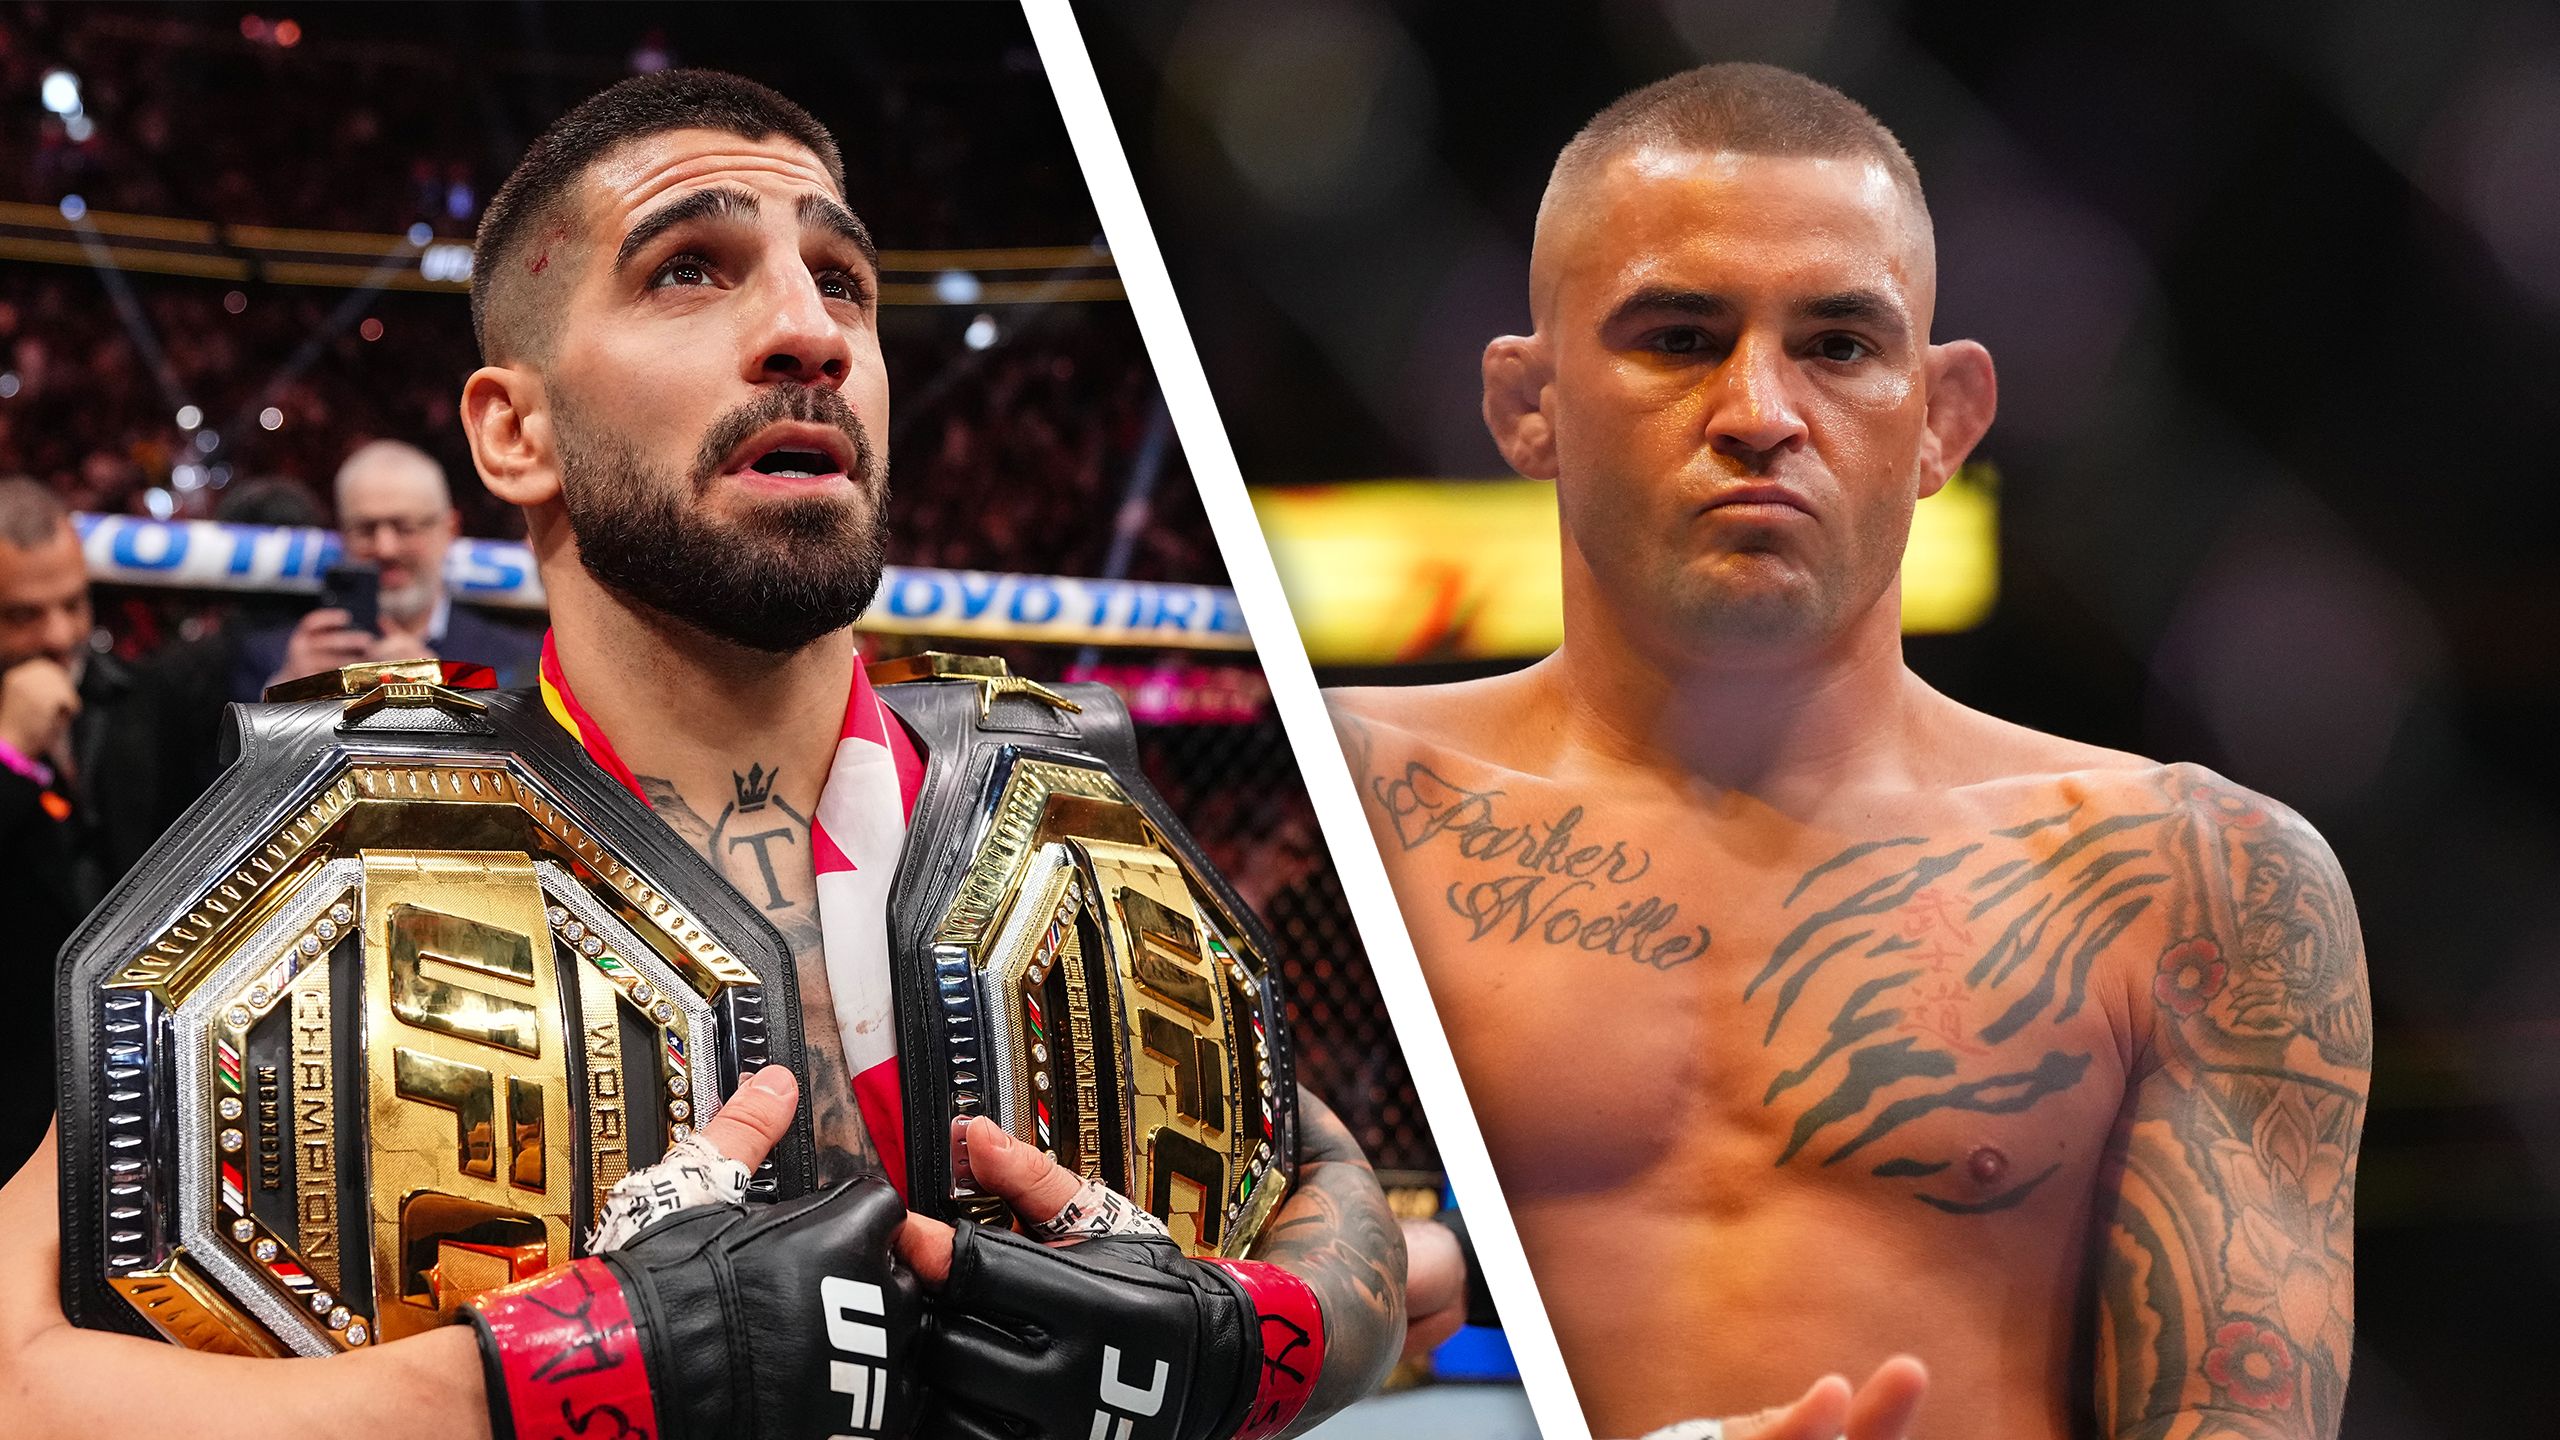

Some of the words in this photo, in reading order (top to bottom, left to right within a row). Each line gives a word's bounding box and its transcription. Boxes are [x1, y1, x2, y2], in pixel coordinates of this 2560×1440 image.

[1373, 761, 1650, 884] Parker
[298, 990, 333, 1259] CHAMPION
[385, 902, 549, 1310] UFC
[590, 1020, 624, 1191] WORL
[1112, 885, 1225, 1249] UFC
[820, 1275, 888, 1440] UF
